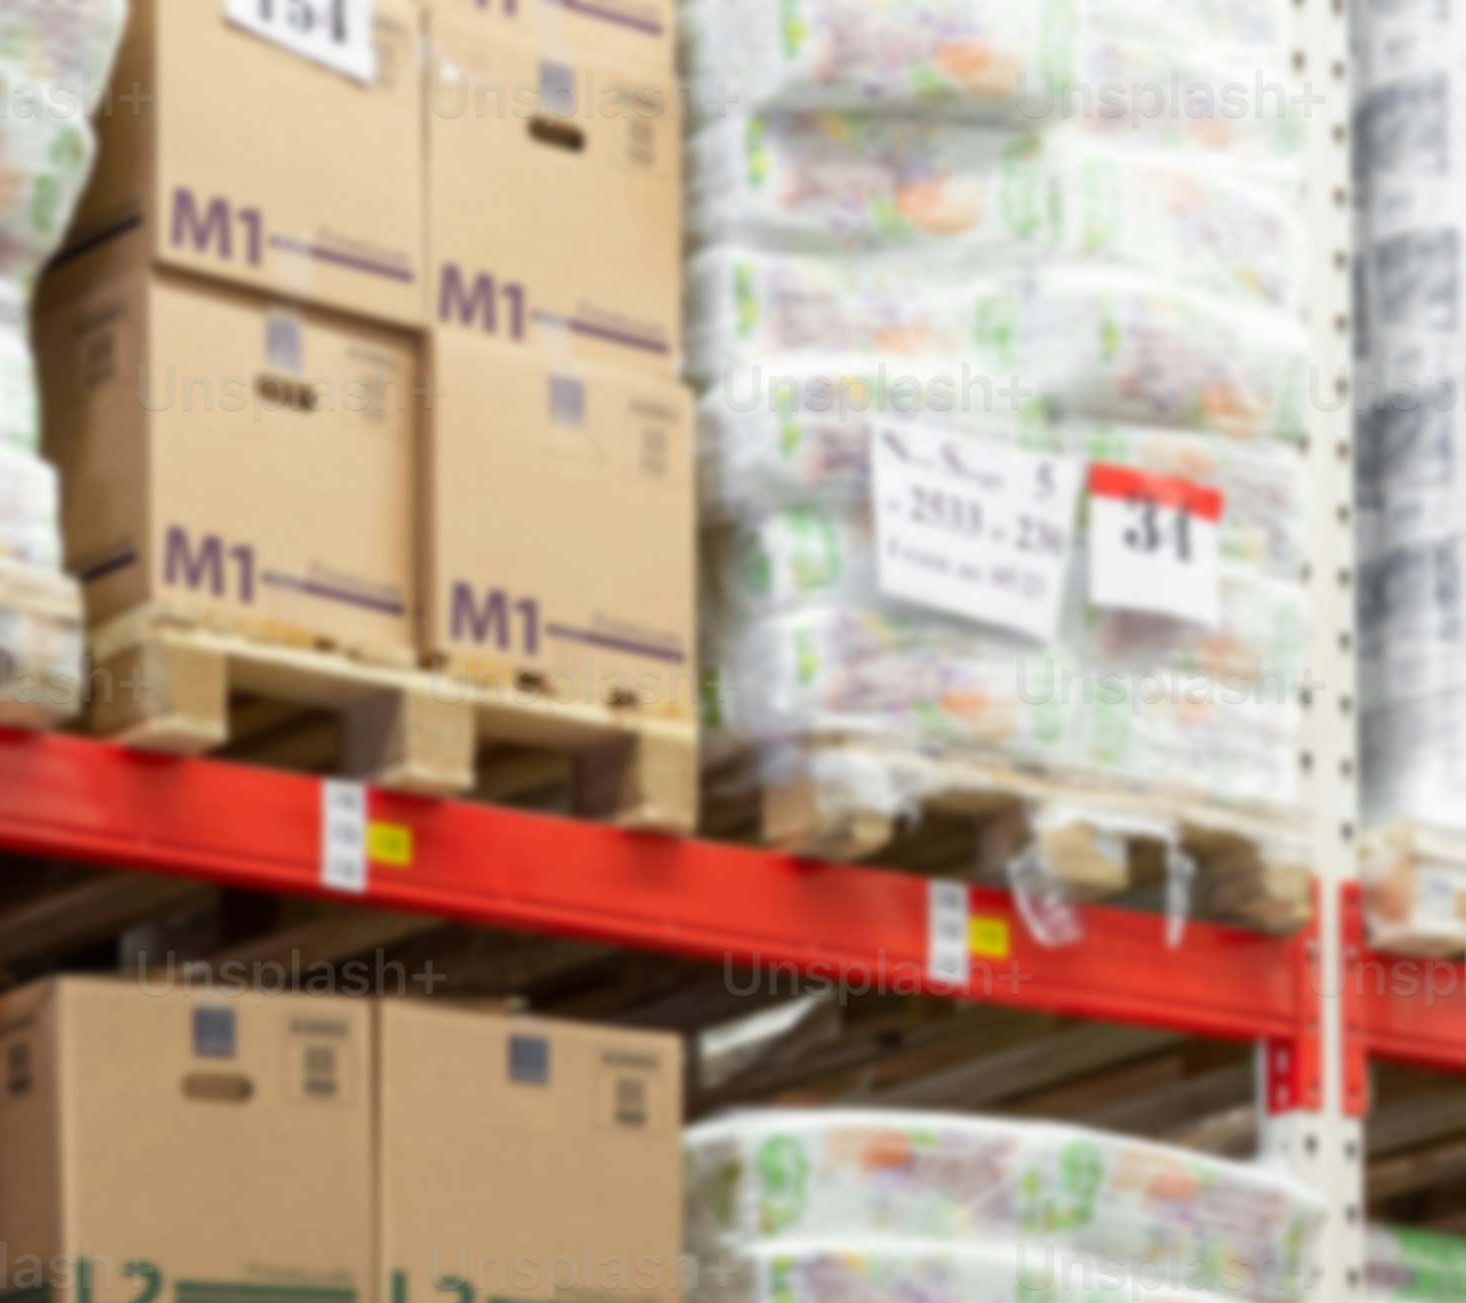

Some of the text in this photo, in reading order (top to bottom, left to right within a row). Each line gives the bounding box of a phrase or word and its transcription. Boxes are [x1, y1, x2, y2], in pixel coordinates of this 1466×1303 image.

[170, 187, 262, 267] M1
[438, 263, 526, 341] M1
[163, 523, 255, 604] M1
[450, 580, 539, 657] M1
